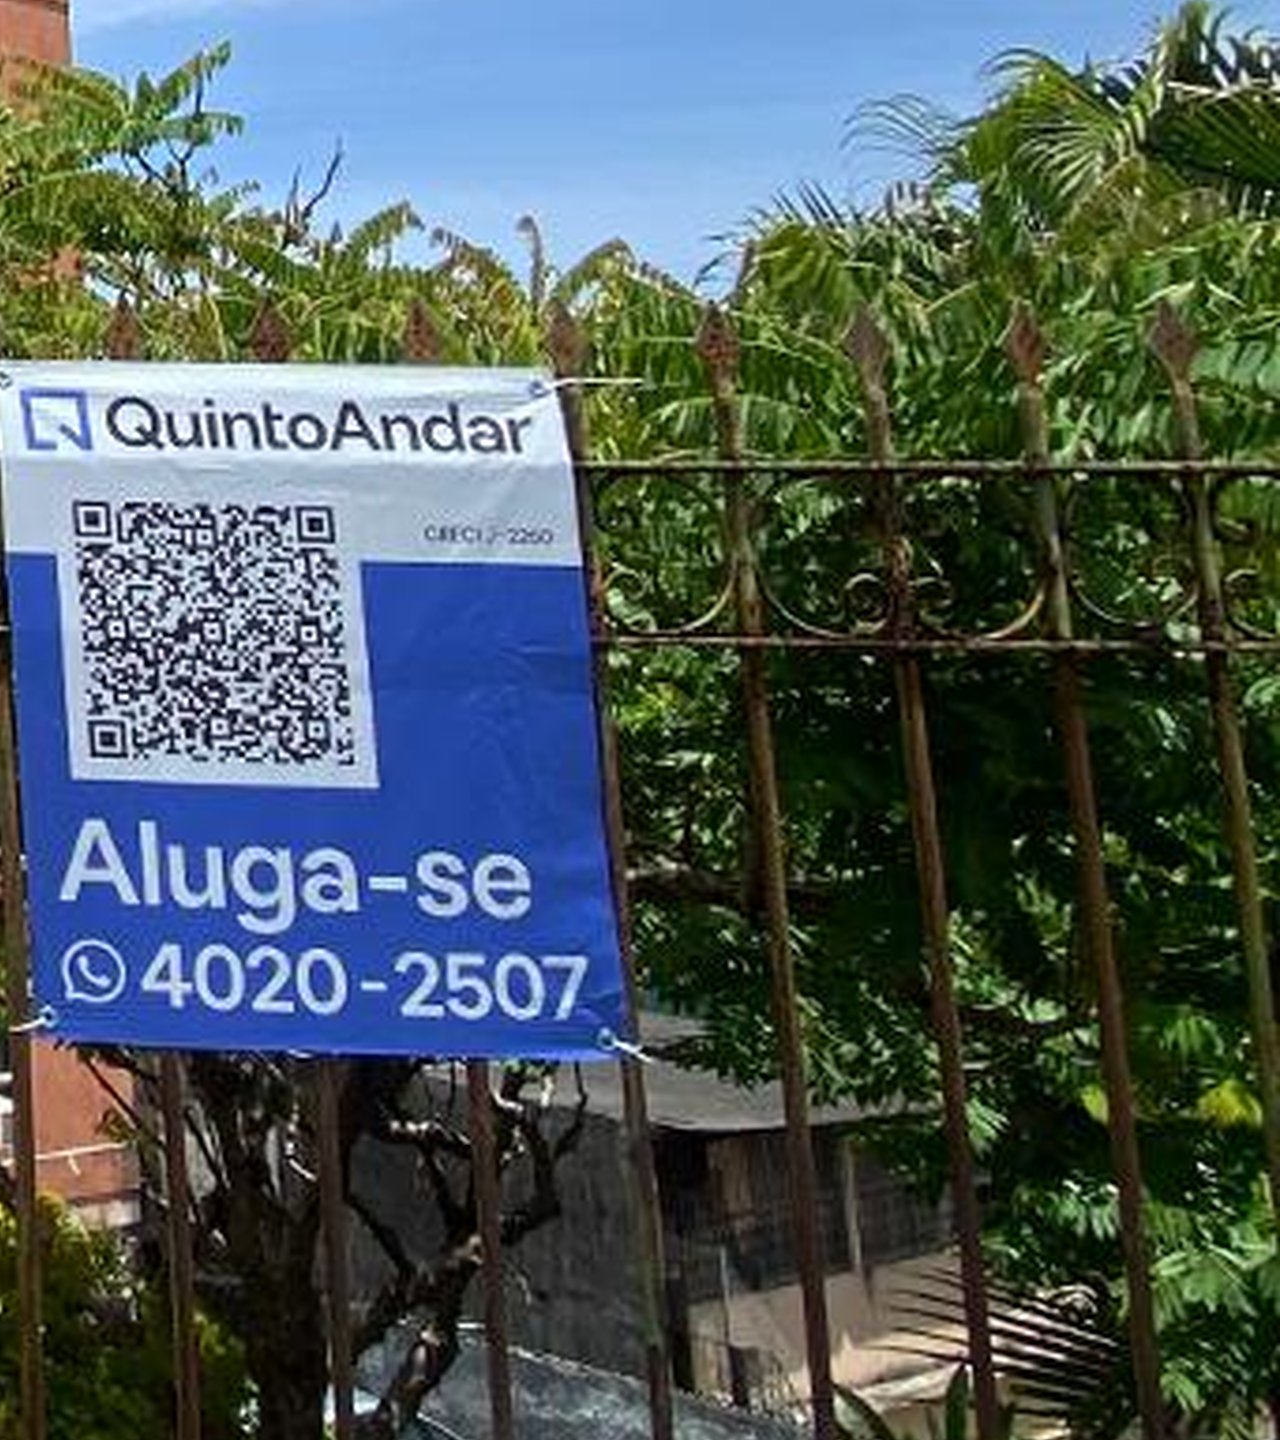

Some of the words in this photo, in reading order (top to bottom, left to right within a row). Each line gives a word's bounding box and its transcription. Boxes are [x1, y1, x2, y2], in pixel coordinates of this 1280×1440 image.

[106, 396, 532, 455] QuintoAndar
[59, 819, 532, 934] Aluga-se
[142, 943, 590, 1020] 4020-2507
